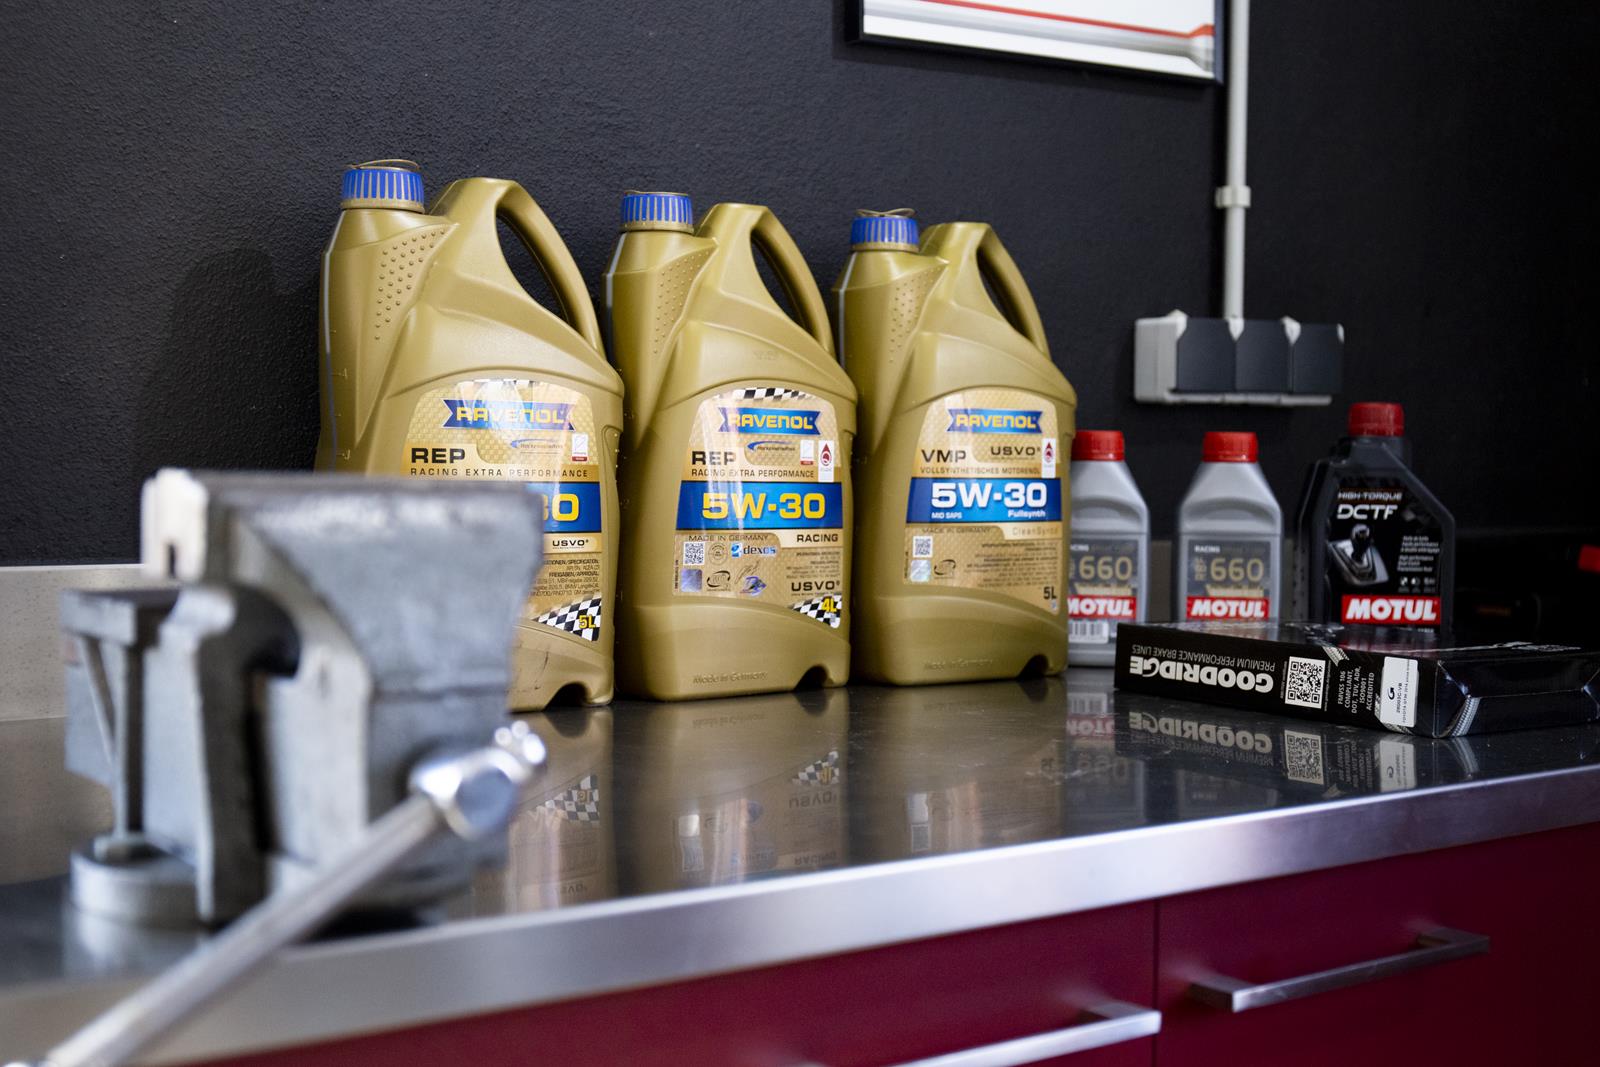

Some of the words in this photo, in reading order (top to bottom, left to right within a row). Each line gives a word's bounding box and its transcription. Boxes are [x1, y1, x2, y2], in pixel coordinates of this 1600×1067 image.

[456, 406, 563, 424] RAVENOL
[728, 413, 813, 429] RAVENOL
[955, 414, 1037, 429] RAVENOL
[411, 447, 466, 463] REP
[691, 450, 736, 466] REP
[921, 449, 967, 463] VMP
[410, 467, 459, 477] RACING
[465, 468, 503, 477] EXTRA
[509, 469, 588, 478] PERFORMANCE
[691, 469, 726, 477] RACING
[729, 469, 756, 477] EXTRA
[758, 469, 814, 478] PERFORMANCE
[920, 466, 1000, 475] VOLLSYNTHETISCHES
[931, 481, 1047, 509] 5W-30
[701, 492, 826, 520] 5W-30
[1008, 509, 1046, 519] Fullsynth
[1337, 503, 1399, 520] DCTF
[796, 533, 839, 543] RACING
[743, 544, 777, 555] dexos
[1069, 544, 1090, 552] ACING
[1194, 545, 1221, 553] RACING
[1078, 555, 1133, 580] 660
[1209, 556, 1264, 582] 660
[1043, 586, 1058, 600] 5L
[820, 598, 838, 613] 4L
[1068, 598, 1133, 616] MOTUL
[1190, 599, 1266, 617] MOTUL
[1345, 598, 1437, 621] MOTUL
[578, 613, 597, 629] 5L
[1131, 643, 1152, 655] LINES
[1152, 647, 1177, 660] BRAKE
[1178, 650, 1236, 667] PERFORMANCE
[1236, 657, 1276, 673] PREMIUM
[1129, 655, 1274, 694] GOODRIDGE
[1354, 665, 1362, 682] ADR,
[1337, 683, 1345, 705] FMVSS
[1344, 669, 1354, 709] COMPLIANT,
[1359, 677, 1367, 704] ISO9001
[1366, 672, 1375, 711] ACCREDITED
[1351, 697, 1359, 714] DOT,
